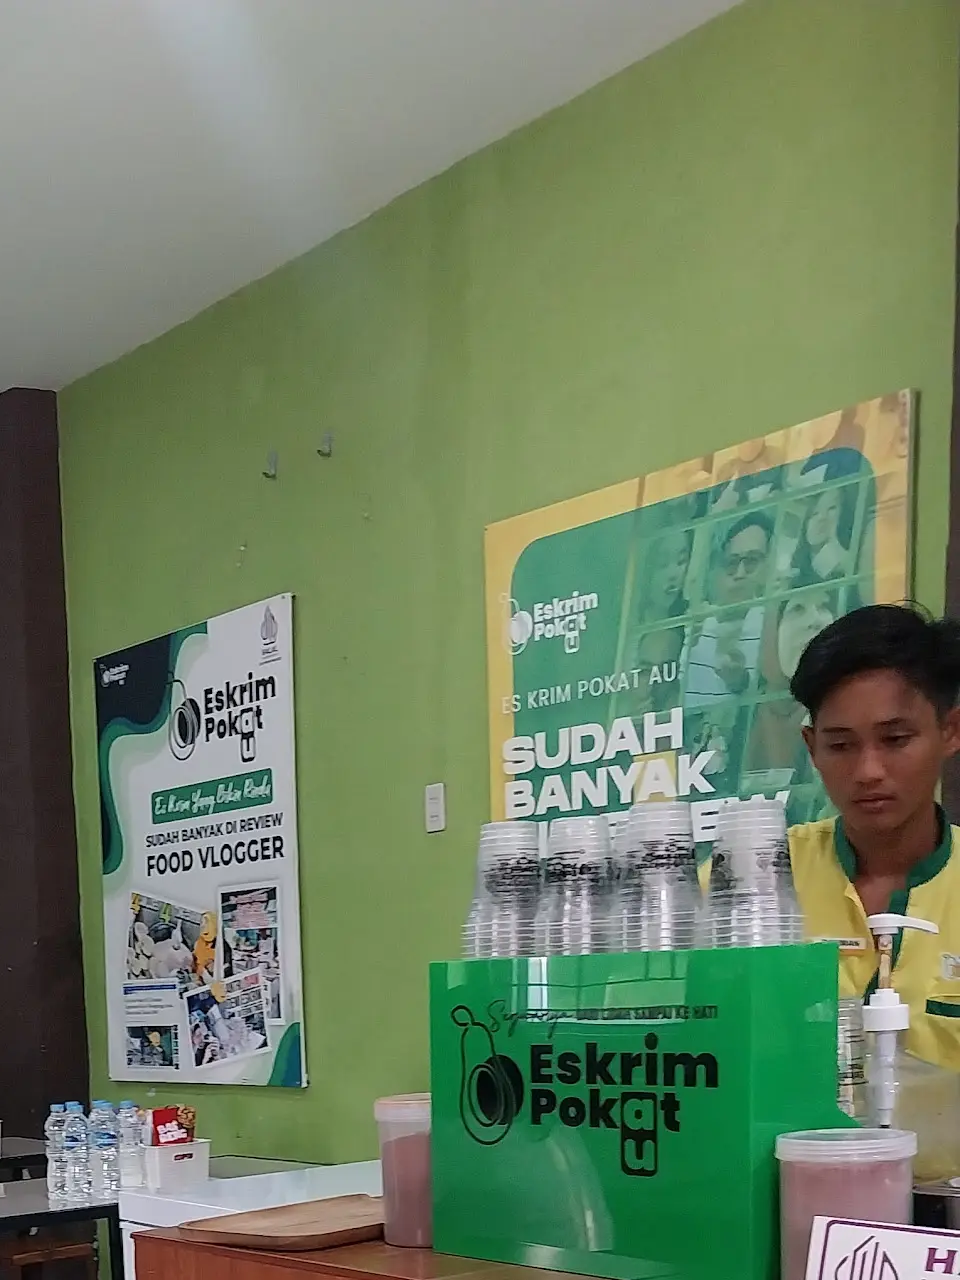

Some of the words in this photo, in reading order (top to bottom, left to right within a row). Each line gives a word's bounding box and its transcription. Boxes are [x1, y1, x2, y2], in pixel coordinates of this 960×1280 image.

[533, 591, 599, 622] Eskrim
[203, 671, 276, 715] Eskrim
[502, 696, 521, 714] ES
[528, 683, 571, 709] KRIM
[578, 668, 642, 699] POKAT
[503, 706, 683, 775] SUDAH
[504, 751, 716, 820] BANYAK
[146, 831, 180, 848] SUDAH
[181, 822, 223, 842] BANYAK
[226, 820, 237, 835] DI
[240, 812, 284, 833] REVIEW
[147, 850, 193, 876] FOOD
[198, 835, 284, 869] VLOGGER
[530, 1032, 719, 1088] Eskrim
